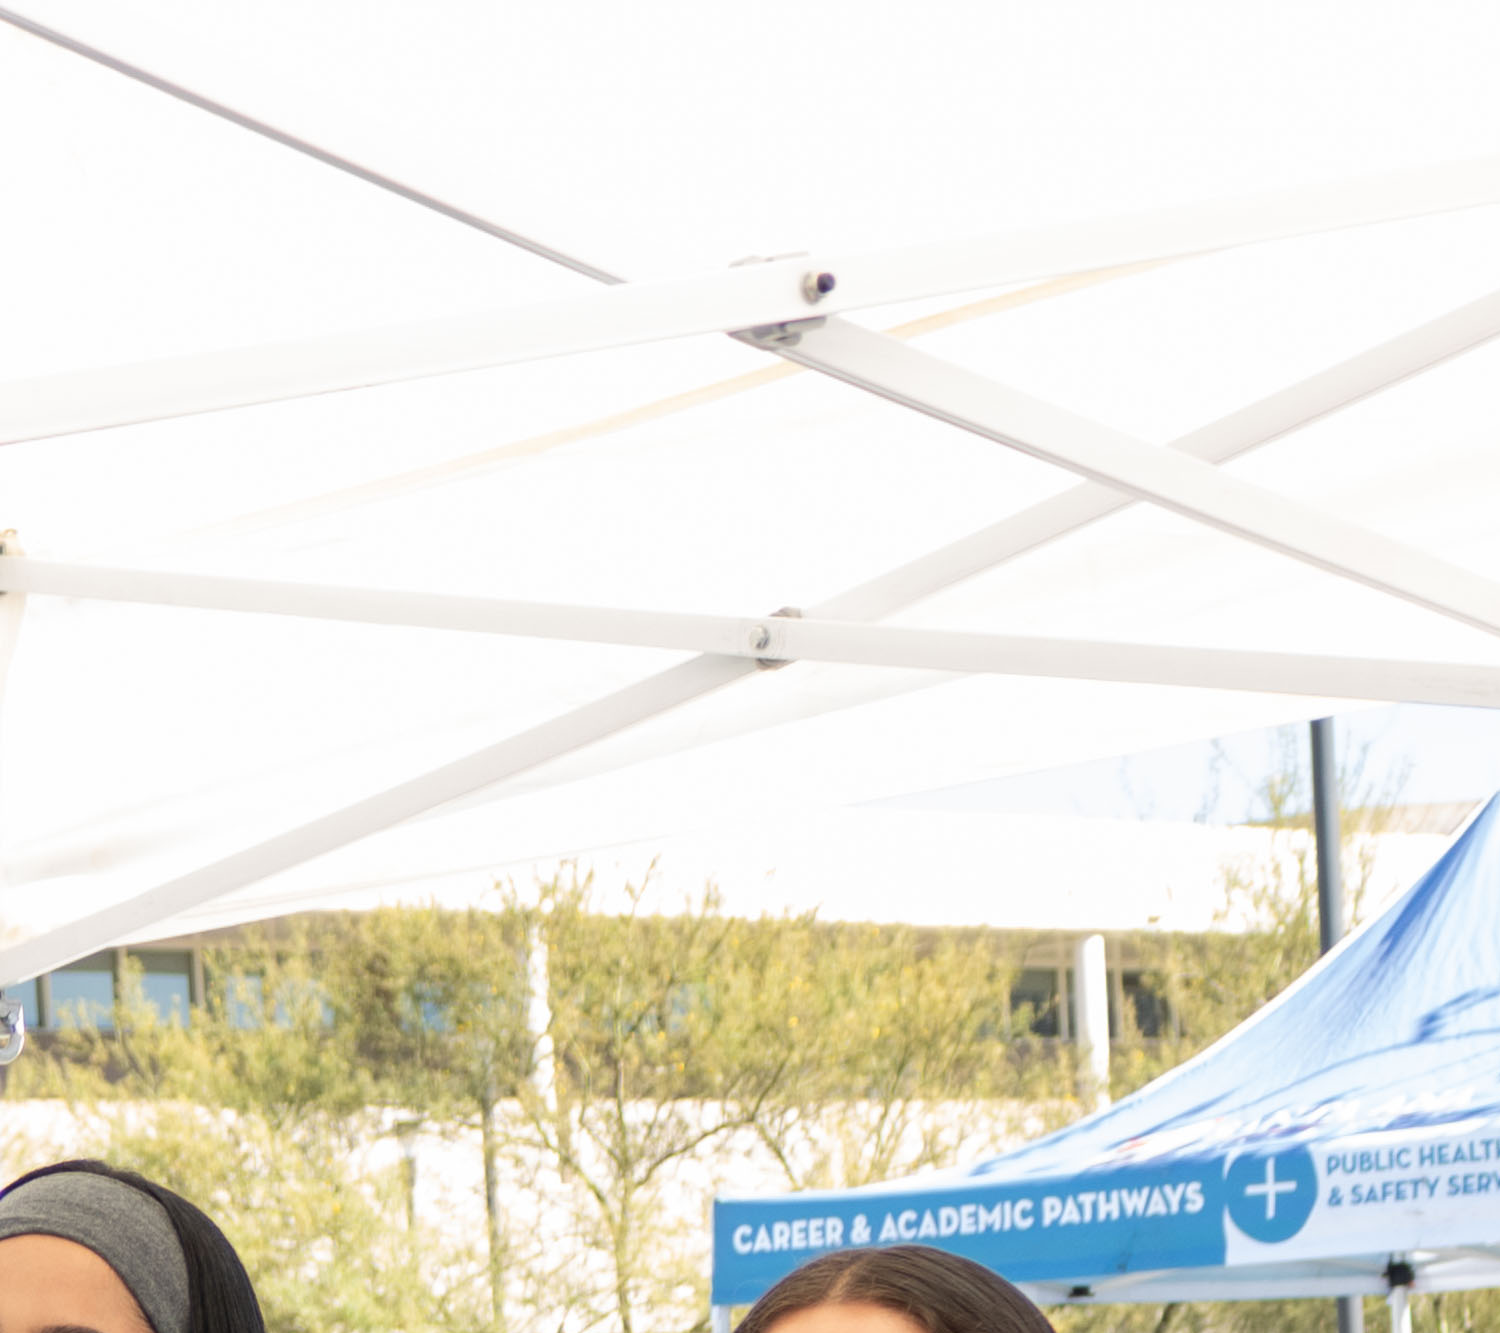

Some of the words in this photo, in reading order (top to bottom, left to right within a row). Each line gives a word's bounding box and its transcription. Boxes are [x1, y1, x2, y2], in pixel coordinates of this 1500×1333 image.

[1326, 1147, 1411, 1177] PUBLIC
[1326, 1186, 1343, 1207] &
[1350, 1175, 1439, 1205] SAFETY
[732, 1215, 843, 1254] CAREER
[849, 1213, 872, 1245] &
[878, 1197, 1035, 1242] ACADEMIC
[1042, 1180, 1205, 1226] PATHWAYS
